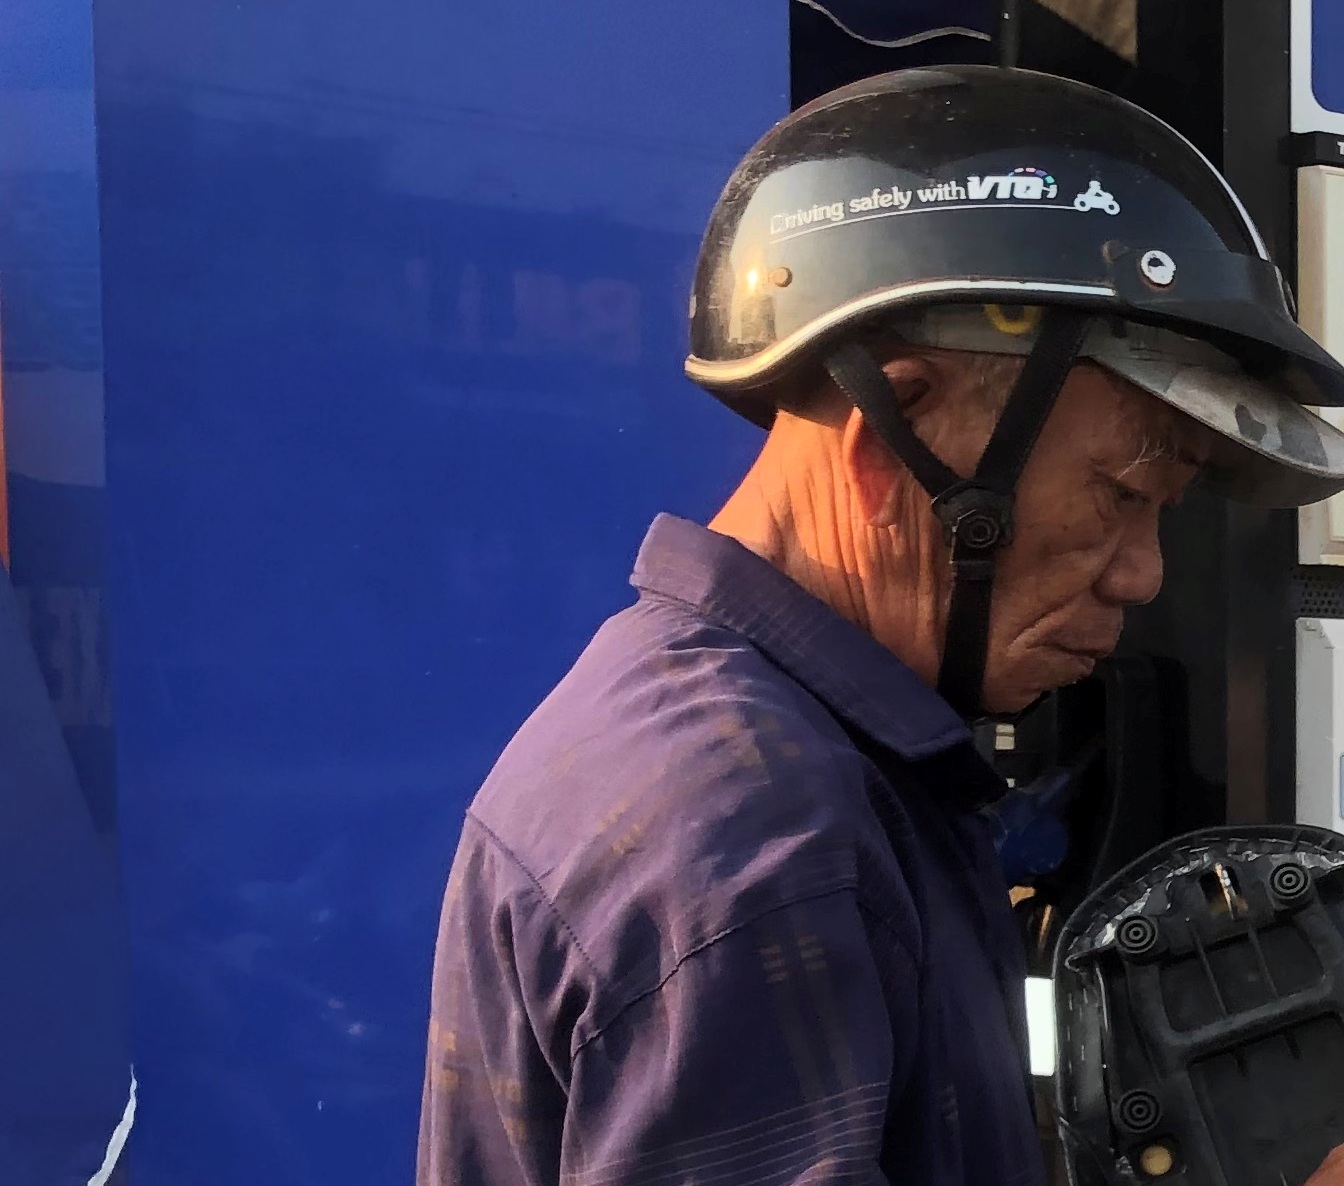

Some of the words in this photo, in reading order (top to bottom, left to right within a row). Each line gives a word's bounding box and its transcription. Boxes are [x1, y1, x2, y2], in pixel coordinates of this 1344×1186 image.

[769, 201, 844, 235] Driving
[849, 187, 912, 214] safely
[917, 182, 967, 204] with
